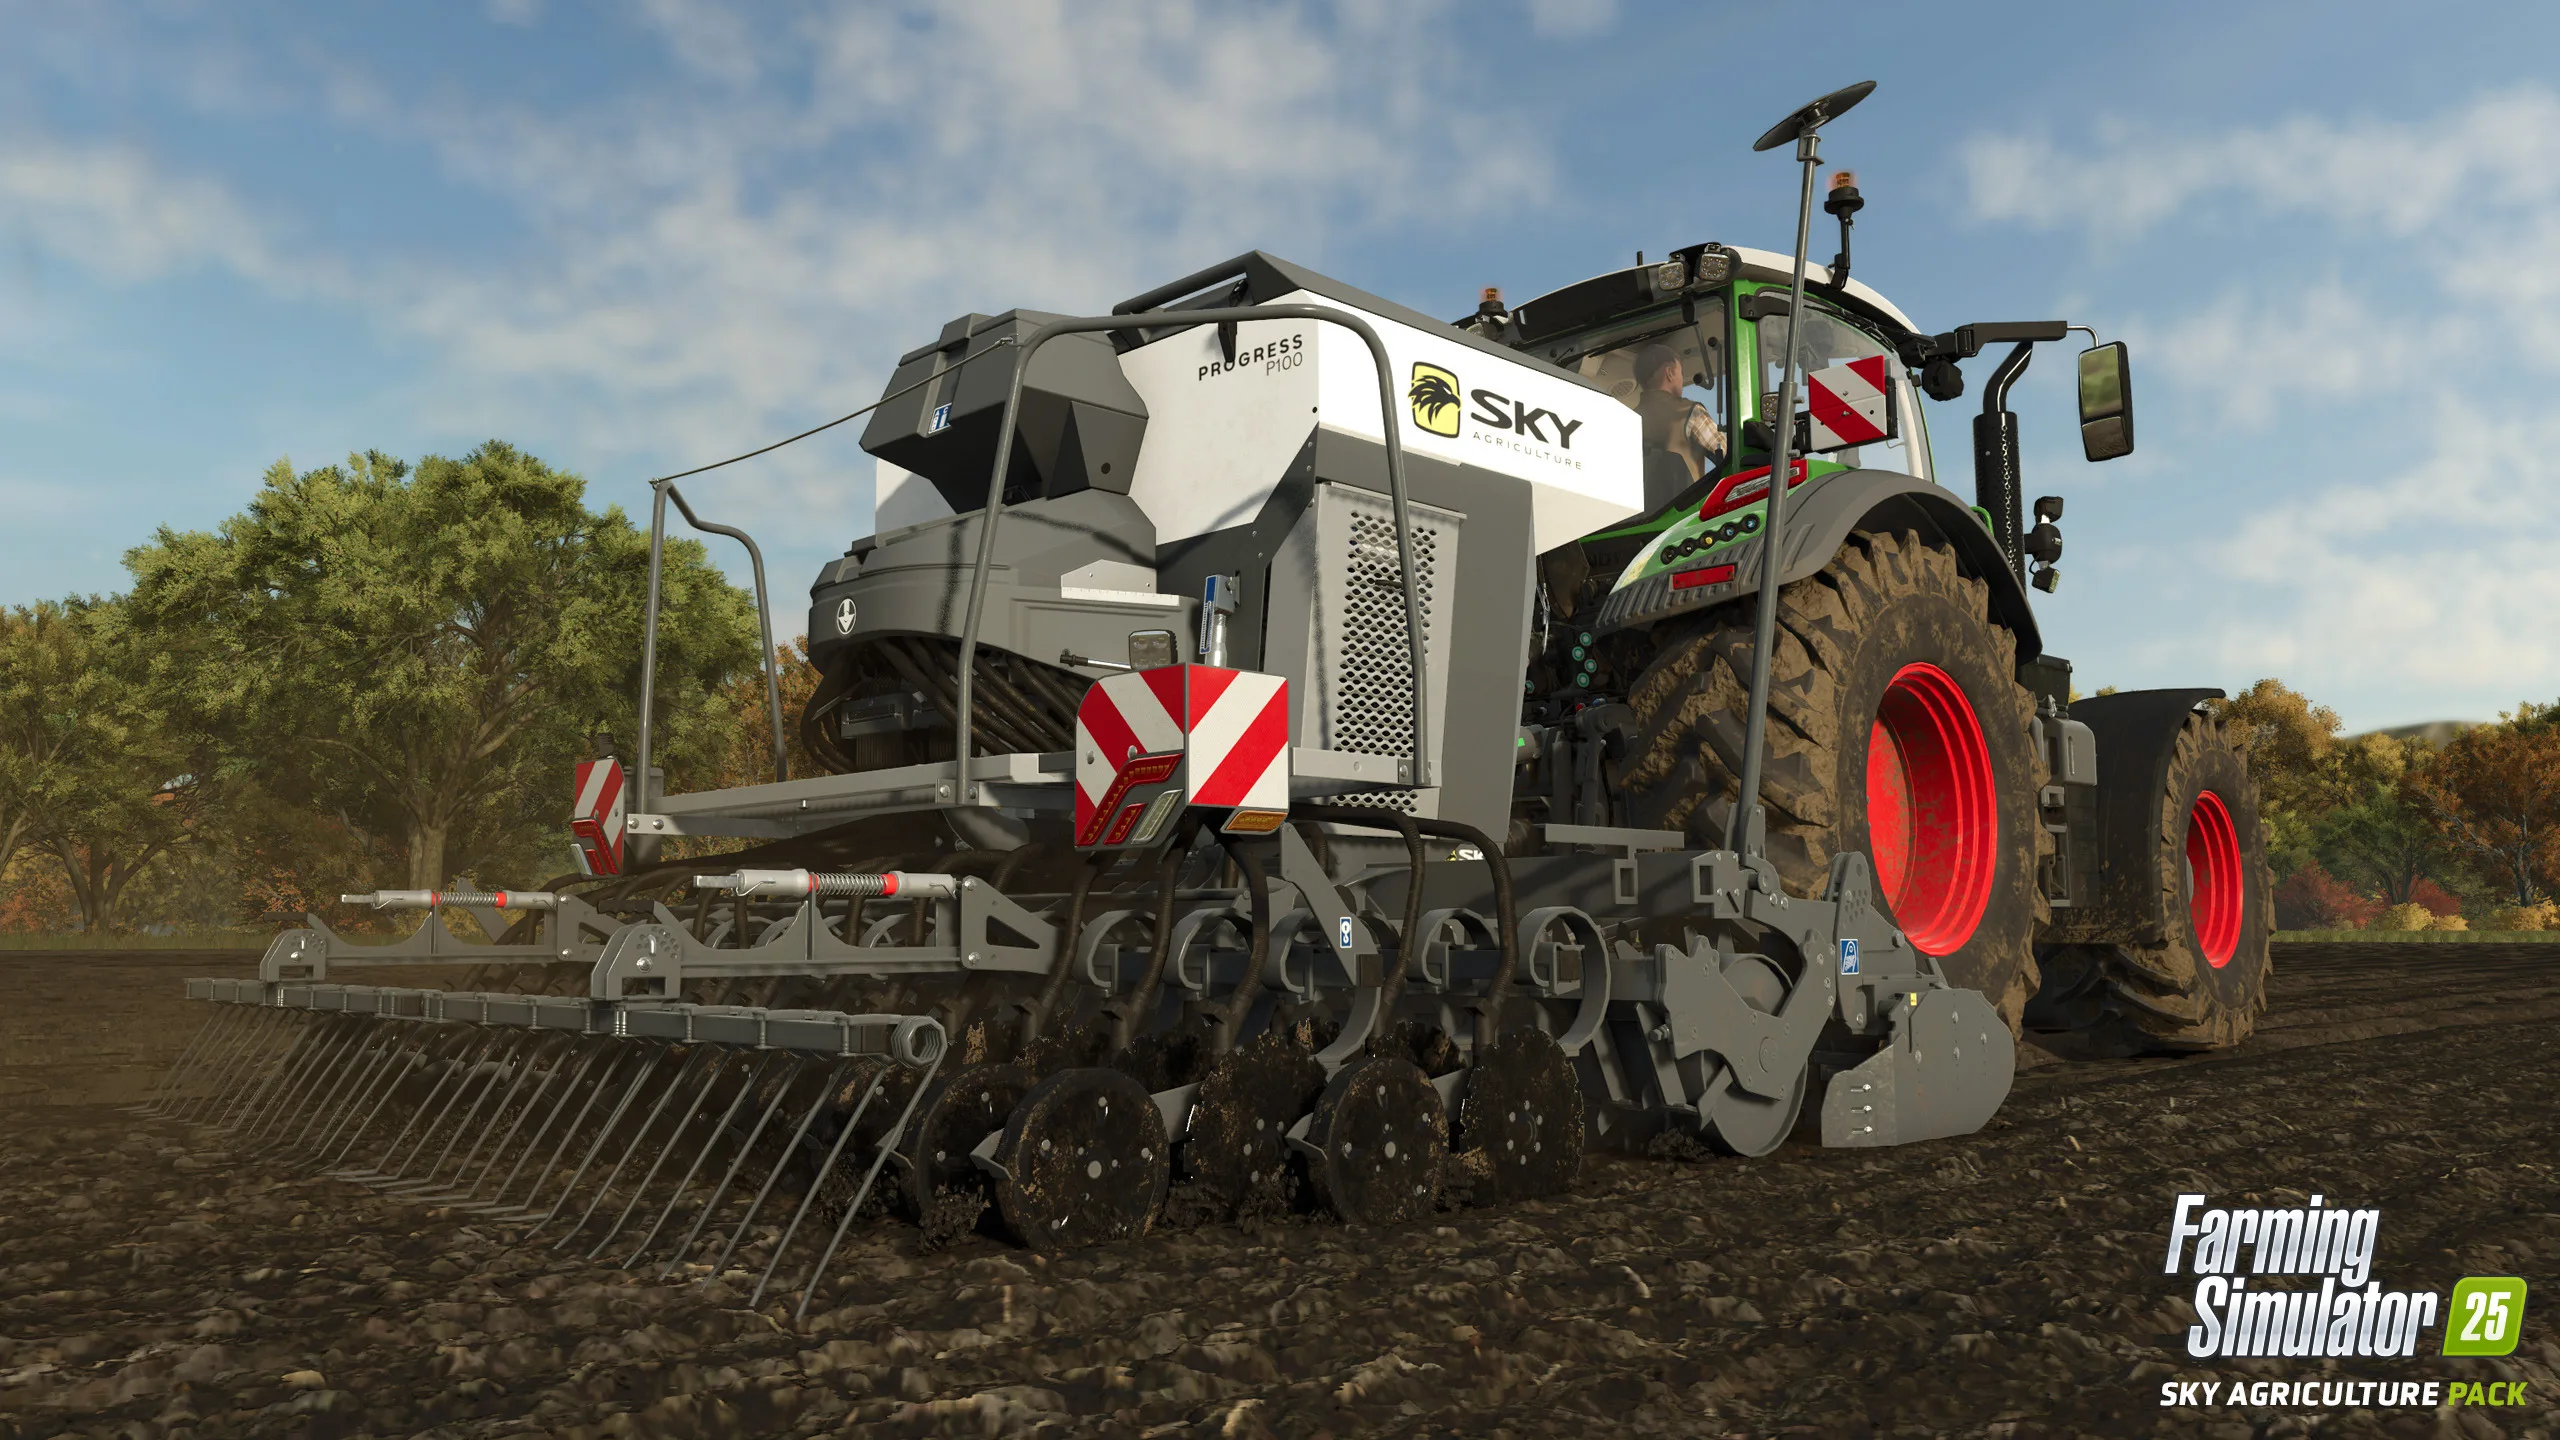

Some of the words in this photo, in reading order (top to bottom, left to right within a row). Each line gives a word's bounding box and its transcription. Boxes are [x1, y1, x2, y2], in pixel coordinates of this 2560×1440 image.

[1198, 333, 1304, 382] PROGRESS
[1265, 351, 1304, 377] P100
[1470, 388, 1584, 450] SKY
[1472, 431, 1583, 471] AGRICULTURE
